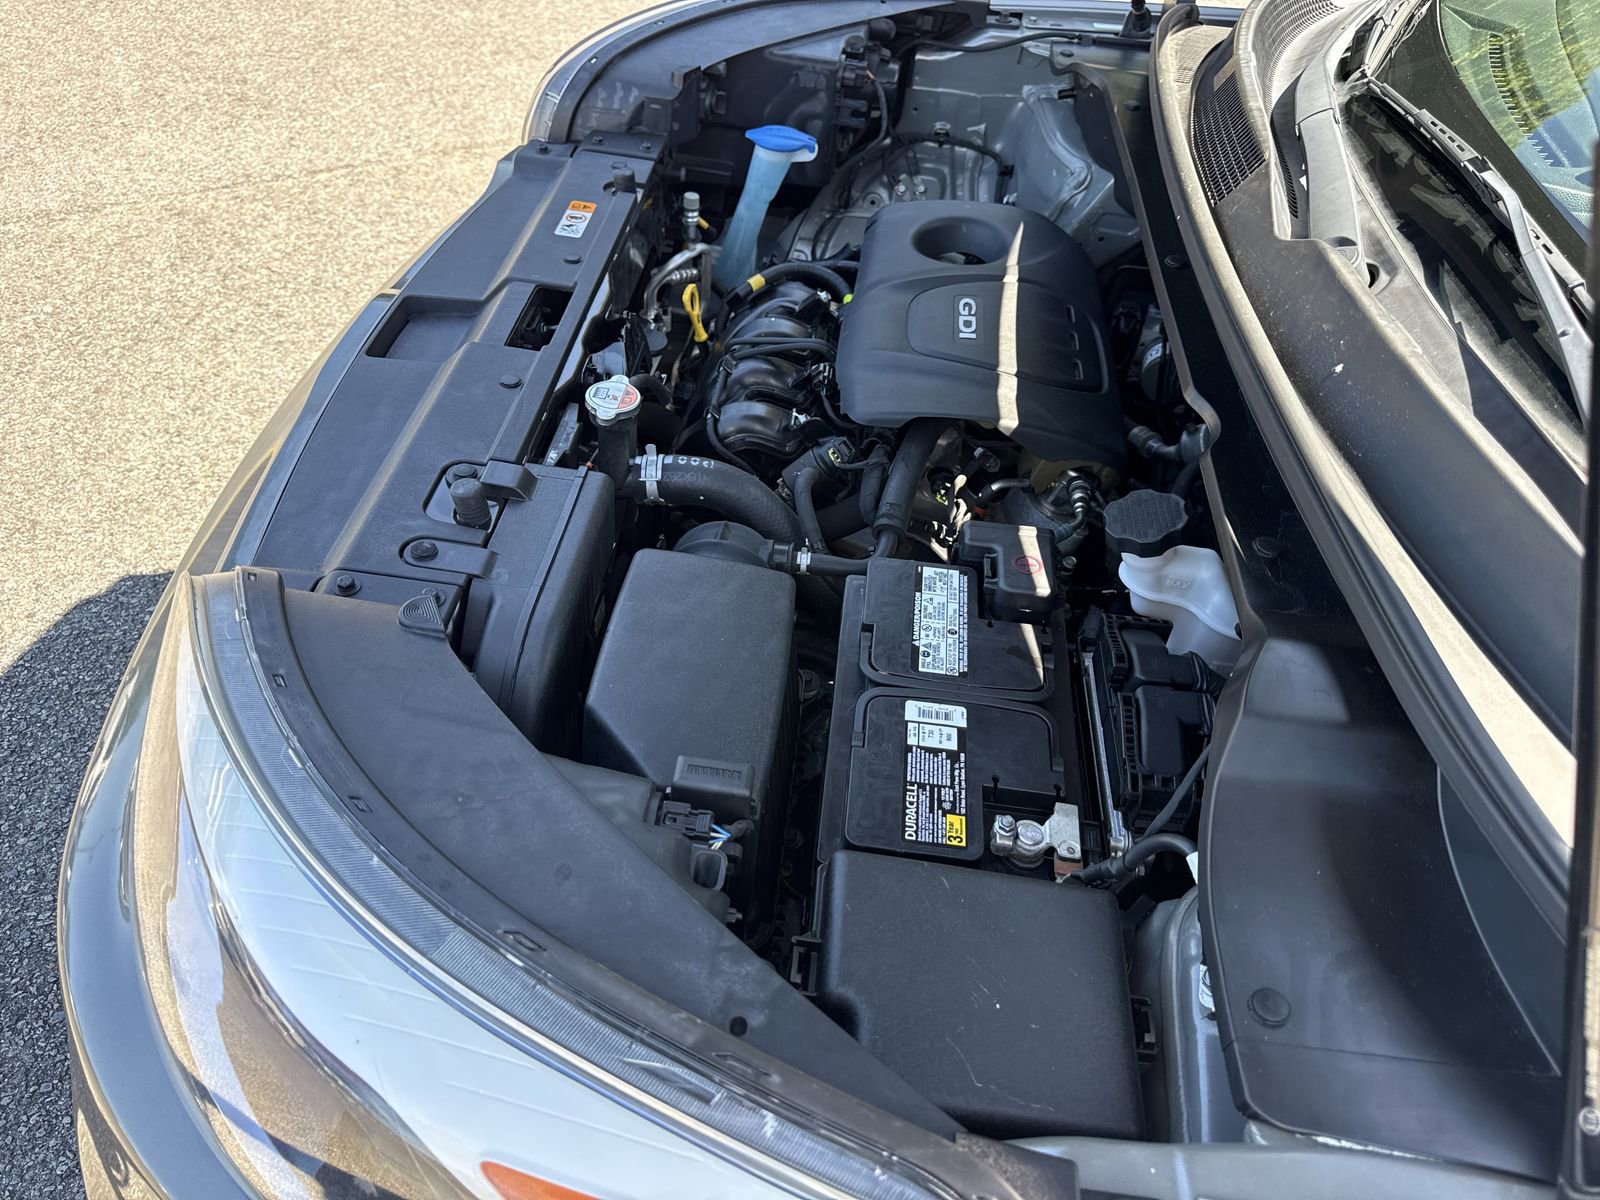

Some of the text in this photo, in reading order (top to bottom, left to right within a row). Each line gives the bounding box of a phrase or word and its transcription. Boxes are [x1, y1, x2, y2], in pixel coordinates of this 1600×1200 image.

[958, 298, 977, 339] GDI
[913, 591, 921, 639] DANGER/POISON
[904, 784, 917, 840] DURACELL
[948, 835, 963, 844] 3
